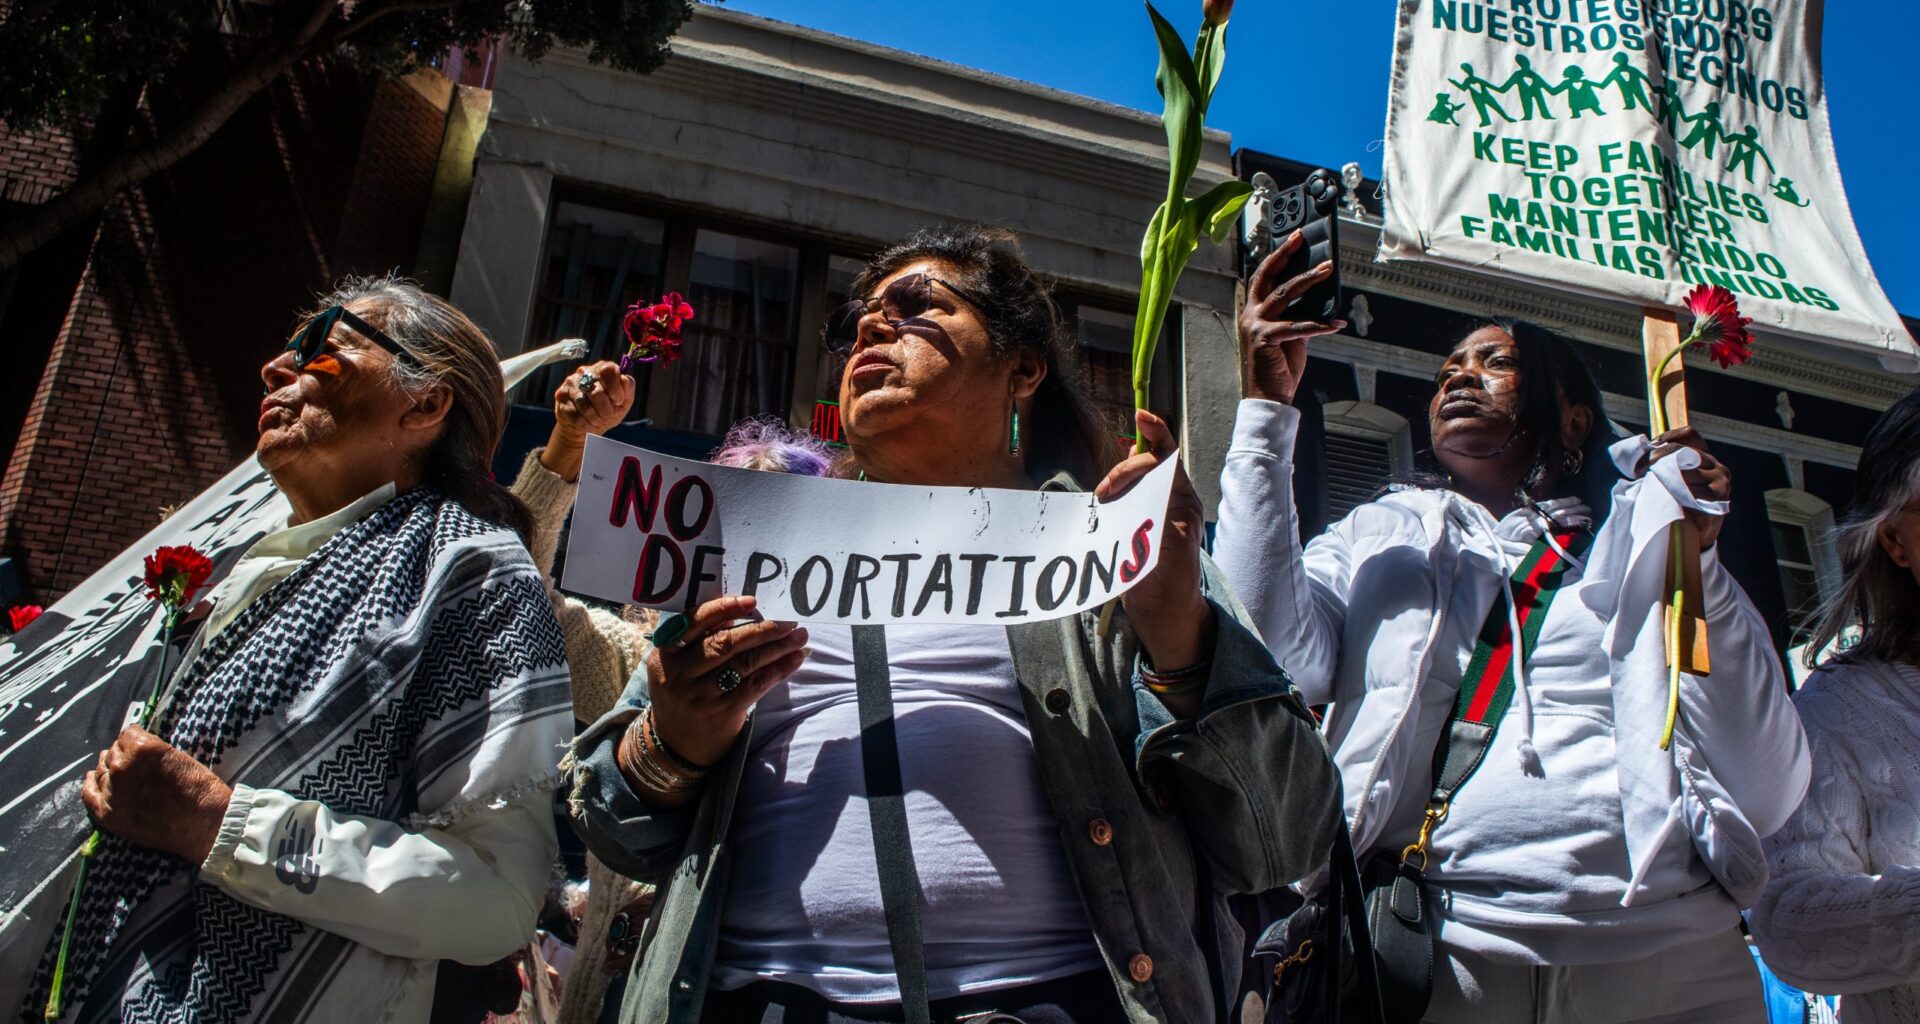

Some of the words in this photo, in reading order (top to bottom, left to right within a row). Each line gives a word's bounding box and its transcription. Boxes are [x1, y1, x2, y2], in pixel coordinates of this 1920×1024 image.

[1432, 0, 1645, 53] NUESTROS
[1655, 37, 1808, 120] VECINOS
[1473, 132, 1578, 172] KEEP
[1599, 140, 1769, 224] FAMILIES
[1523, 171, 1736, 244] TOGETHER
[1460, 215, 1665, 280] FAMILIAS
[1487, 193, 1787, 280] MANTENIENDO
[608, 455, 713, 542] NO
